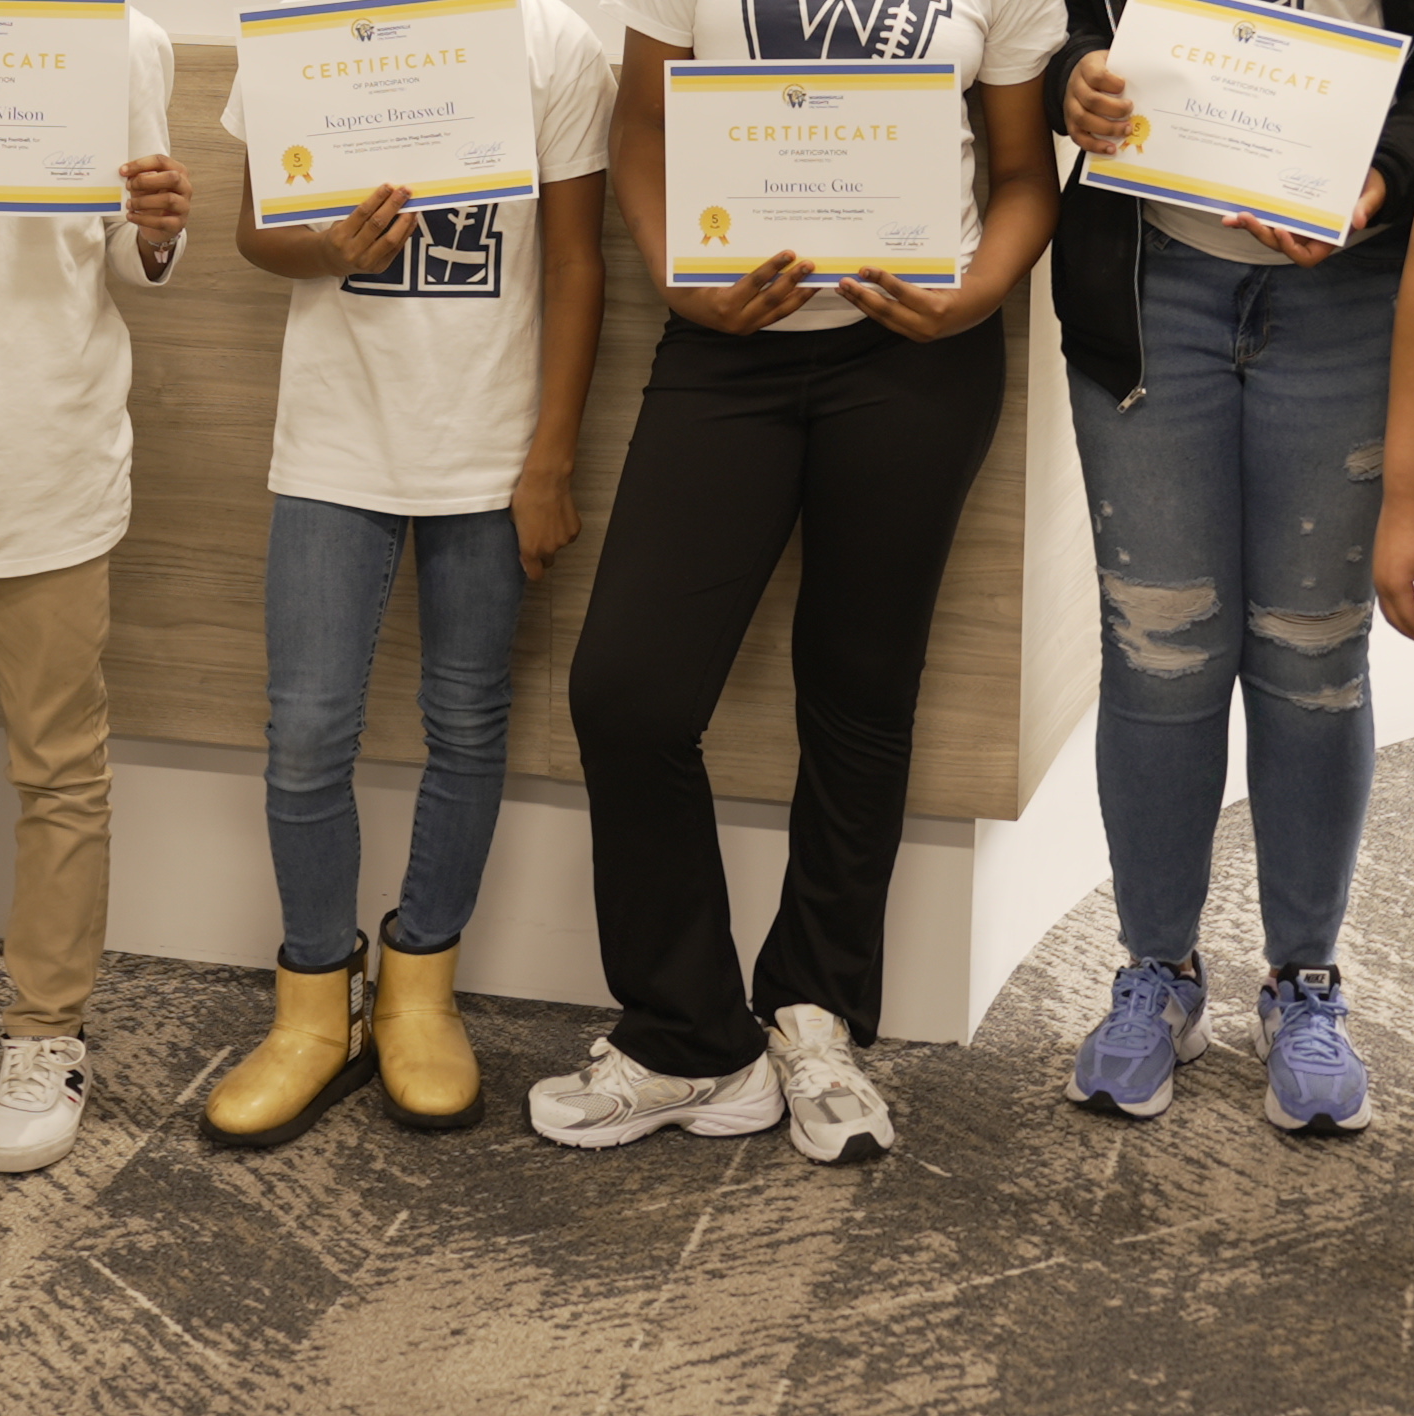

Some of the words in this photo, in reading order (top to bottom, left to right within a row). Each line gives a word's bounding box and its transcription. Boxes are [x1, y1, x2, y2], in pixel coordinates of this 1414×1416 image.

[302, 47, 468, 81] CERTIFICATE
[1171, 44, 1332, 95] CERTIFICATE
[364, 77, 420, 89] PARTICIPATION
[1222, 77, 1277, 97] PARTICIPATION
[325, 112, 383, 130] Kapree
[387, 101, 455, 122] Braswell
[1185, 98, 1227, 119] Rylee
[1231, 109, 1282, 133] Hayles
[728, 125, 899, 142] CERTIFICATE
[764, 178, 826, 193] Journee
[1303, 973, 1327, 984] NIKE
